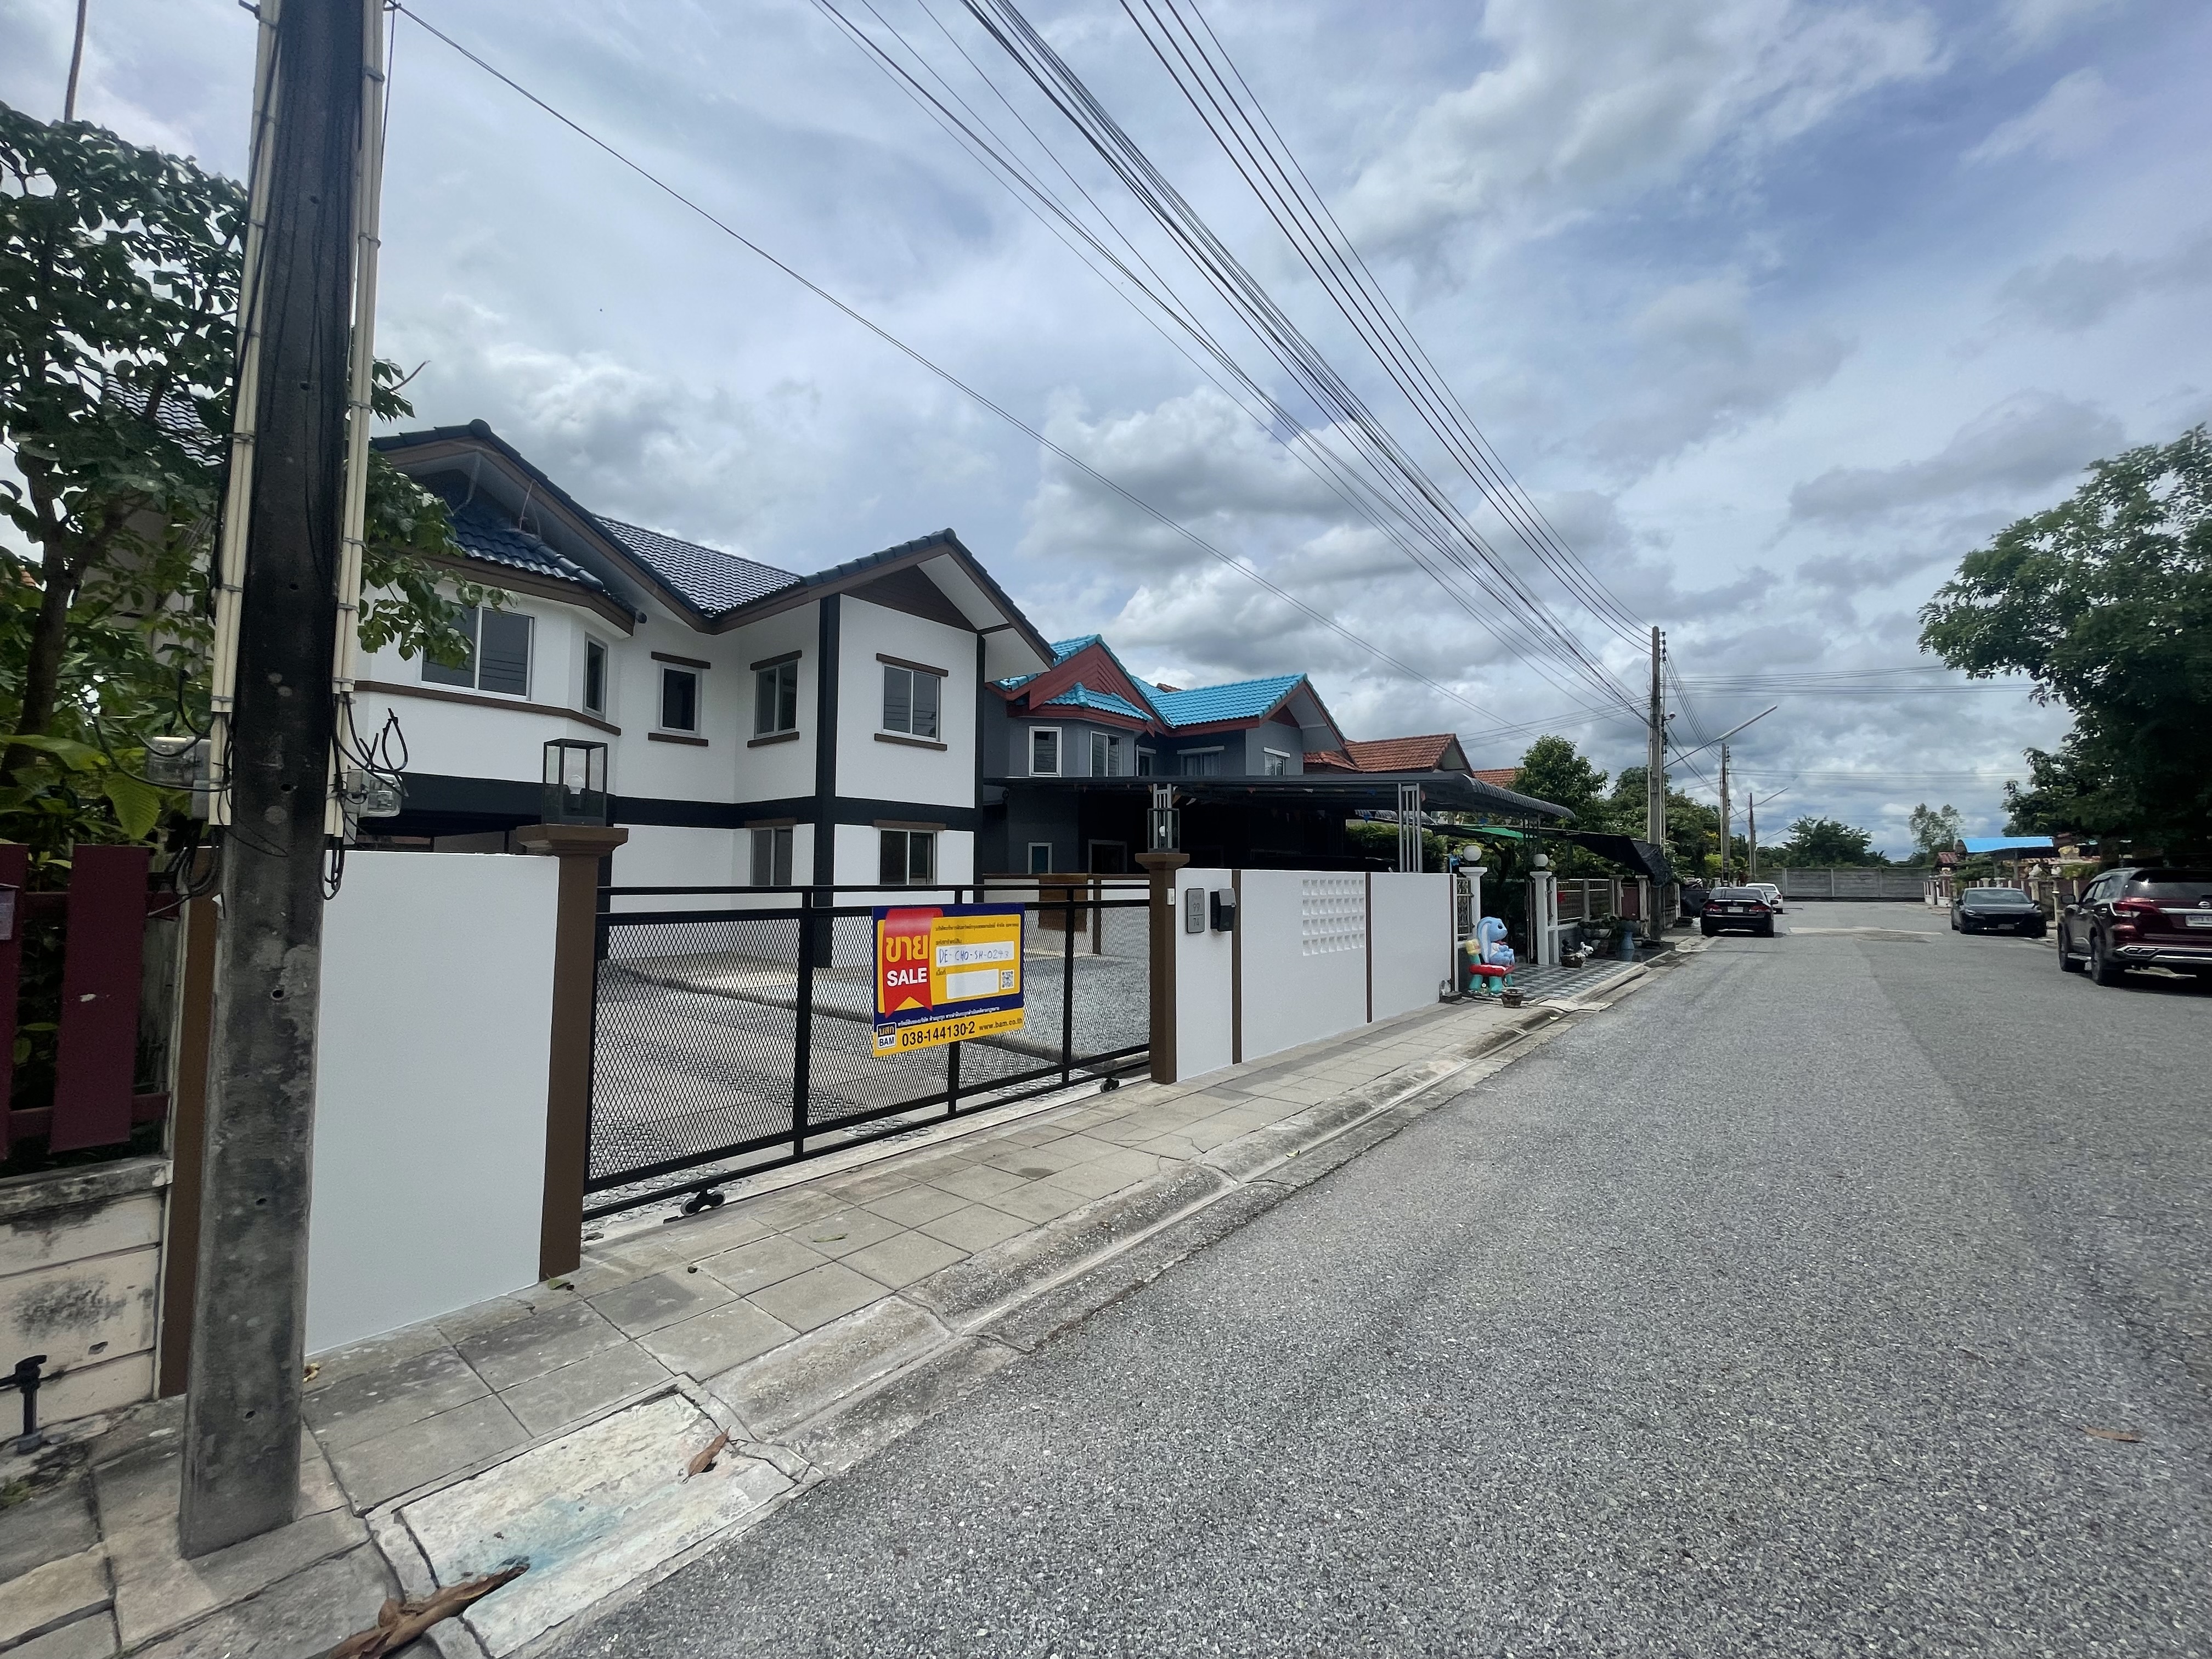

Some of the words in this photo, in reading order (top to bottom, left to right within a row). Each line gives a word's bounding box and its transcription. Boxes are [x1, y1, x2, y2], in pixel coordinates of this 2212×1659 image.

[886, 935, 928, 962] ขาย
[887, 967, 927, 987] SALE
[979, 1018, 1023, 1031] www.bam.co.th
[879, 1036, 894, 1047] BAM
